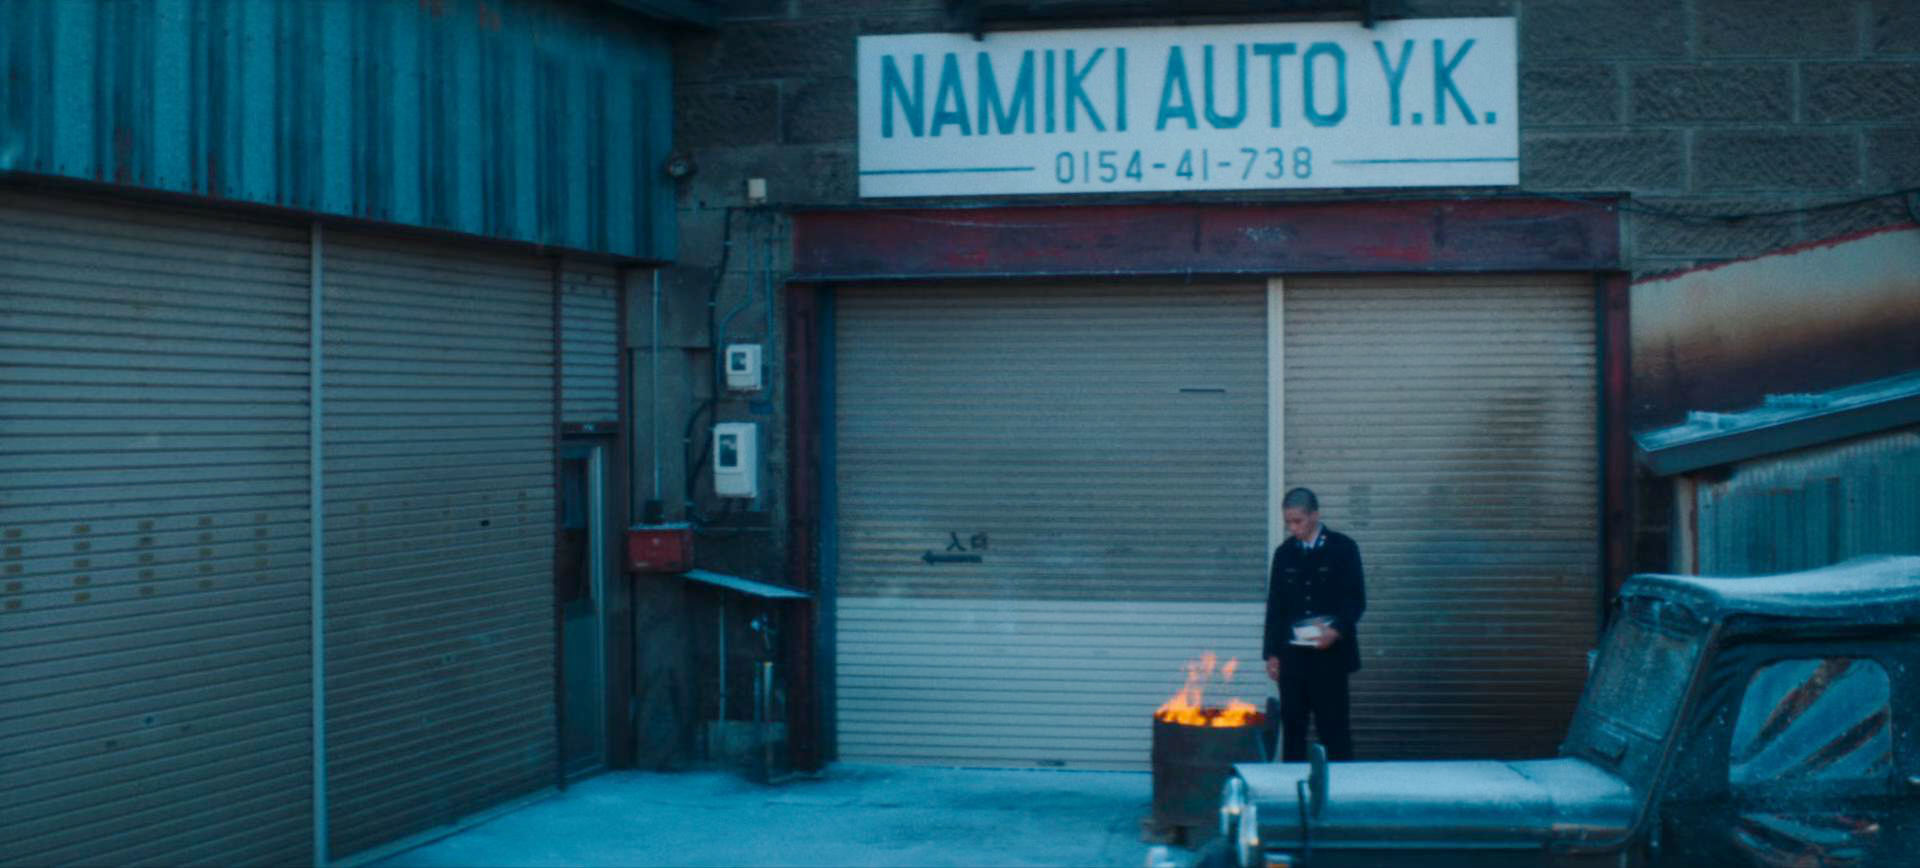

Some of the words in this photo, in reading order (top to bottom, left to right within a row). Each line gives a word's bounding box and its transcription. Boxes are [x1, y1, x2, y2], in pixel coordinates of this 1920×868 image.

[881, 47, 1127, 138] NAMIKI
[1155, 41, 1347, 131] AUTO
[1373, 38, 1497, 126] Y.K.
[1055, 147, 1313, 184] 0154-41-738
